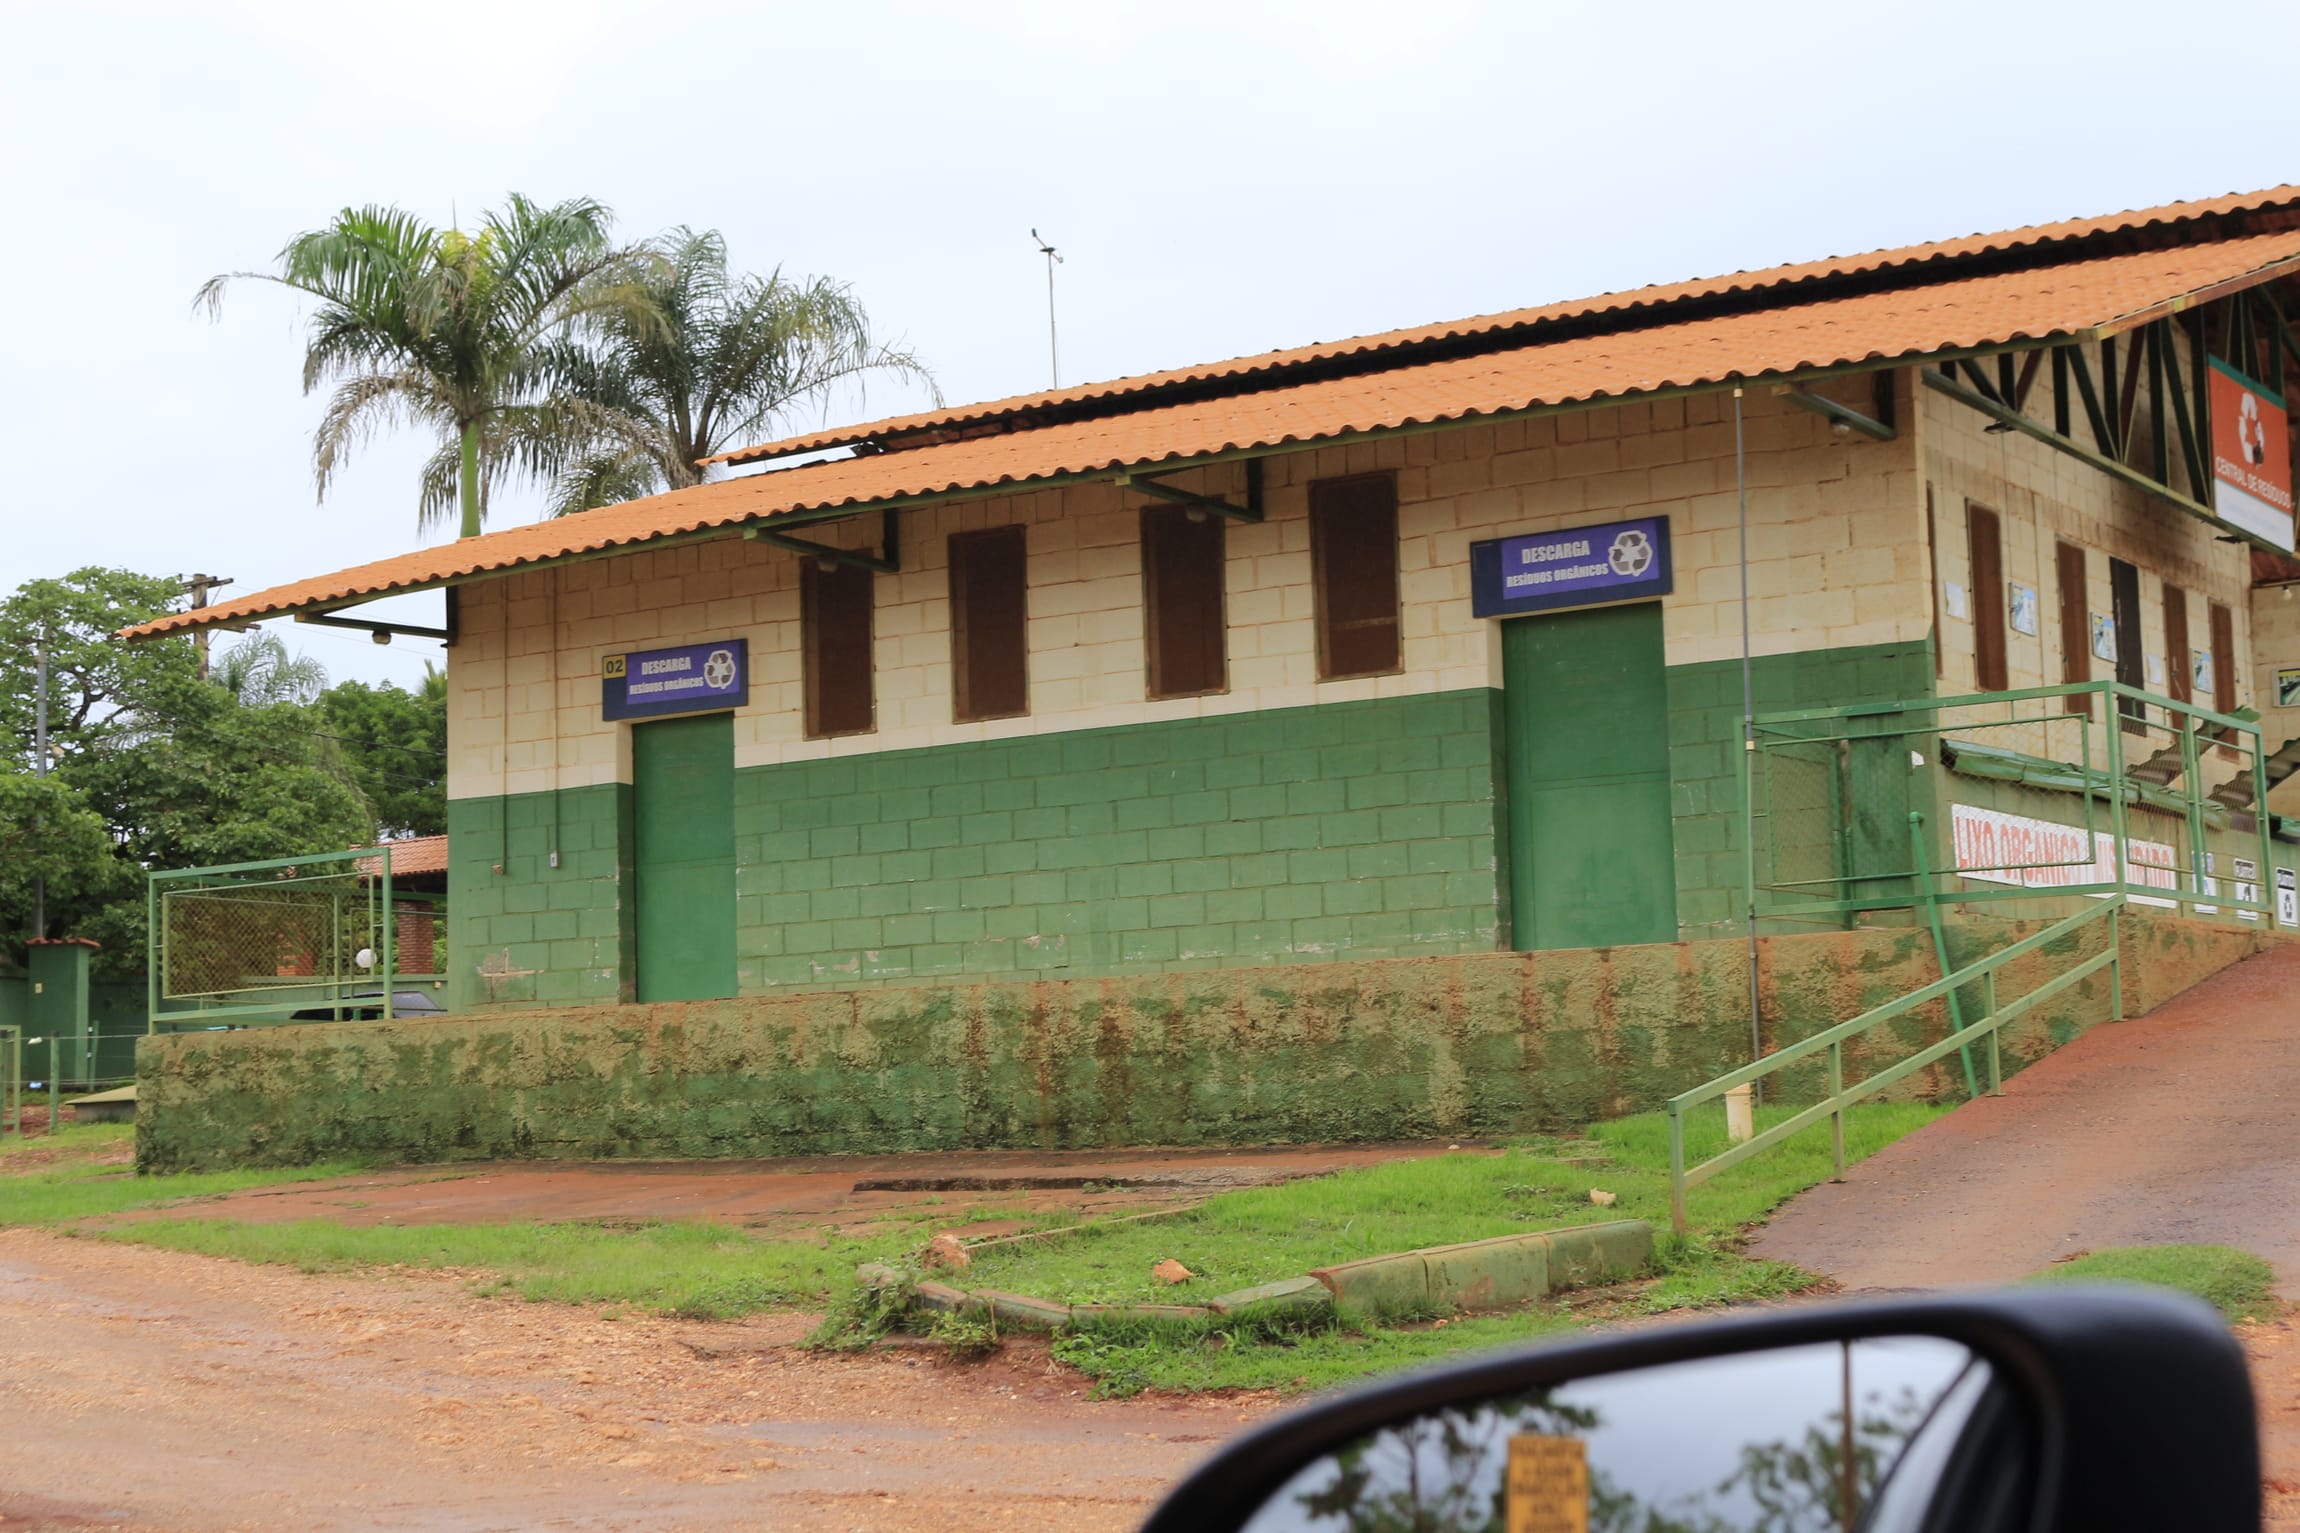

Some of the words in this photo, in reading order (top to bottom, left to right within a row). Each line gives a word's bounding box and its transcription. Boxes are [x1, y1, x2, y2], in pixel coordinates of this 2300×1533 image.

[1522, 540, 1590, 563] DESCARGA
[1506, 571, 1553, 587] RESÍDUOS
[1554, 563, 1608, 580] ORGÂNICOS
[606, 659, 623, 673] 02
[641, 656, 691, 675] DESCARGA
[1955, 816, 1996, 877] LIXO
